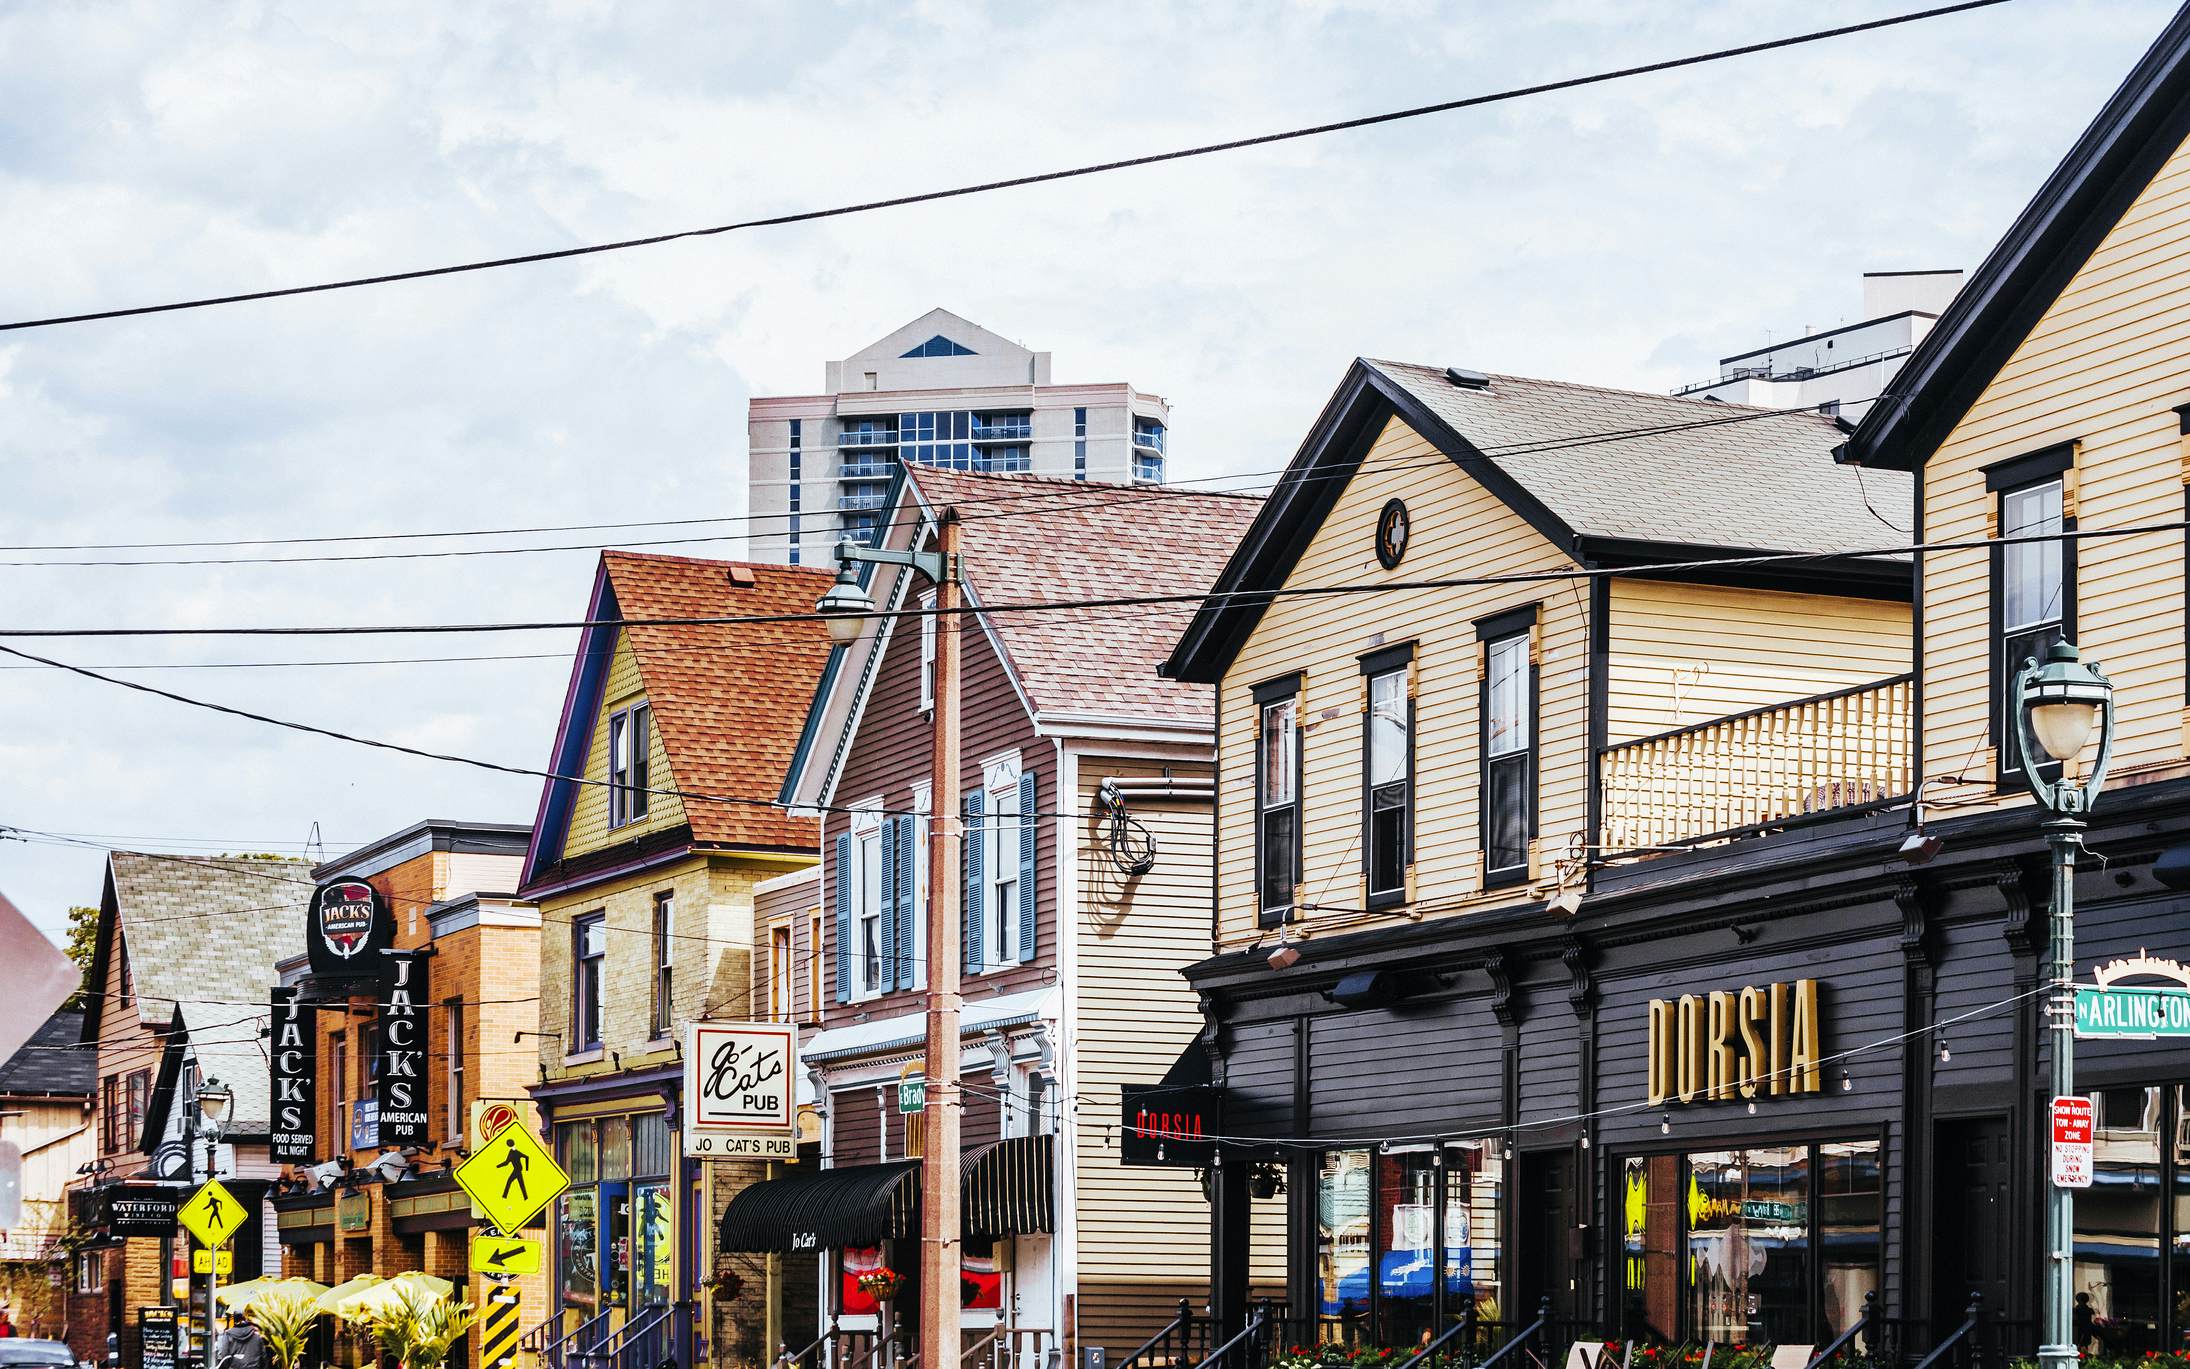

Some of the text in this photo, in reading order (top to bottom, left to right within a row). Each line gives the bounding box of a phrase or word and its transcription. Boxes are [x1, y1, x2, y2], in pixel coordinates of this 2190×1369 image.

[324, 904, 370, 922] JACK'S
[2079, 1002, 2088, 1019] N
[386, 960, 423, 1109] JACK'S
[1648, 979, 1820, 1107] DORSIA
[743, 1095, 779, 1110] PUB
[2054, 1105, 2091, 1117] SNOW ROUTE
[380, 1112, 427, 1124] AMERICAN
[396, 1125, 414, 1136] PUB
[1136, 1112, 1202, 1141] DORSIA
[272, 1133, 314, 1145] FOOD SERVED
[2064, 1130, 2081, 1140] ZONE
[277, 1145, 308, 1156] ALL NIGHT
[696, 1138, 791, 1153] JO CAT'S PUB
[2055, 1144, 2090, 1154] NO STOPPING
[2063, 1154, 2083, 1163] DURING
[2065, 1164, 2080, 1173] SNOW
[112, 1203, 176, 1212] WATERFORD
[792, 1232, 816, 1251] Jo Cat's
[199, 1256, 228, 1269] AHAD
